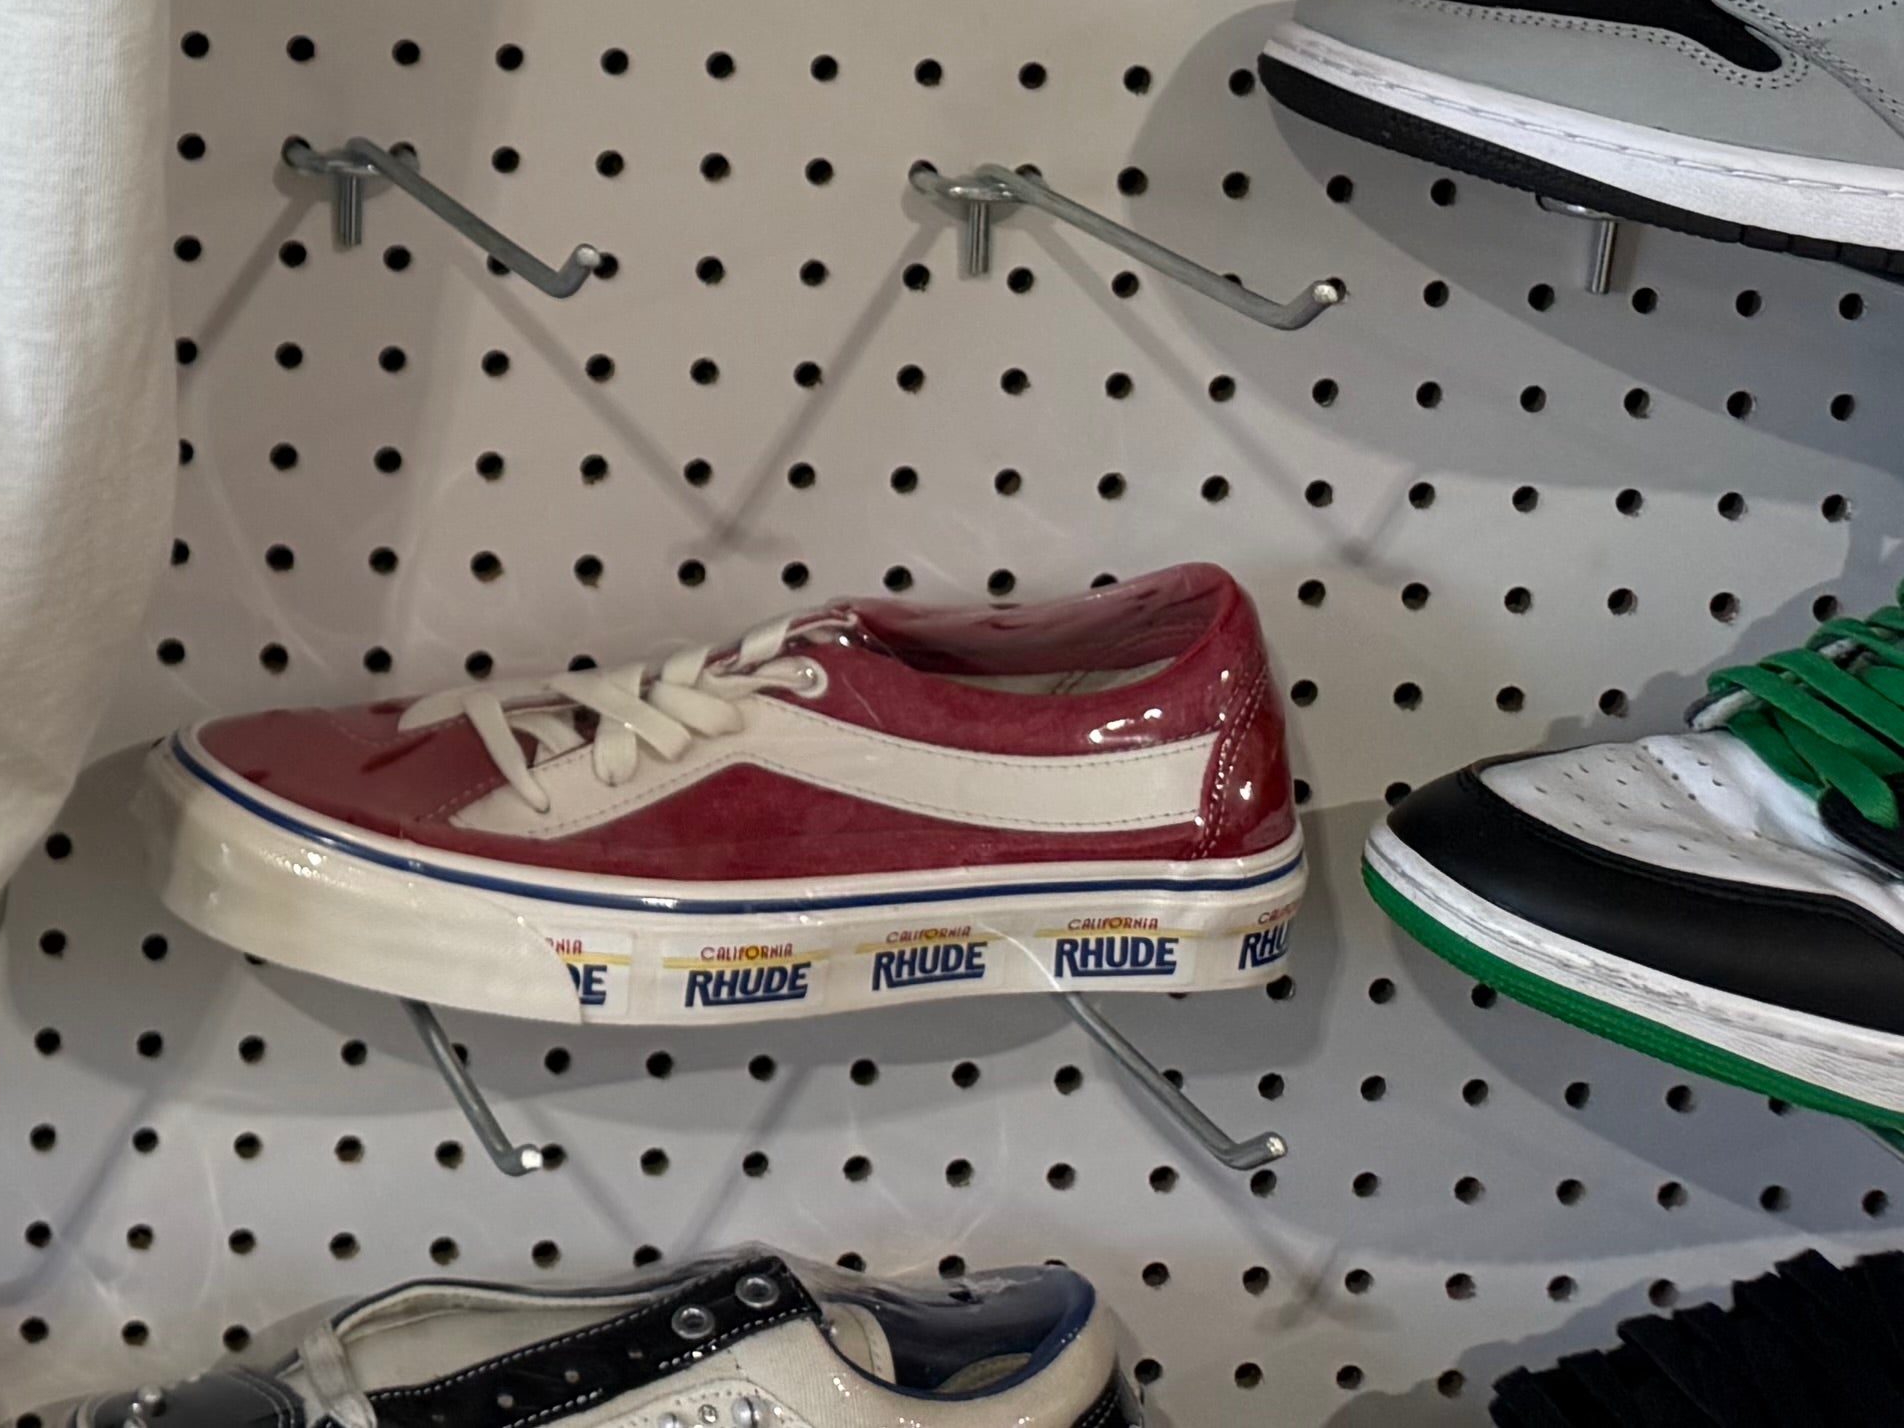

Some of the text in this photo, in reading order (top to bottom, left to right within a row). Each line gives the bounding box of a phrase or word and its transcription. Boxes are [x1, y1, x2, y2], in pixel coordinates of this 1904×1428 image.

[886, 926, 971, 944] CALIFORNIA
[1067, 916, 1159, 931] CALIFORNIA
[701, 943, 793, 962] CALIFORNIA
[872, 941, 988, 991] RHUDE
[1054, 936, 1179, 978] RHUDE
[685, 961, 811, 1007] RHUDE
